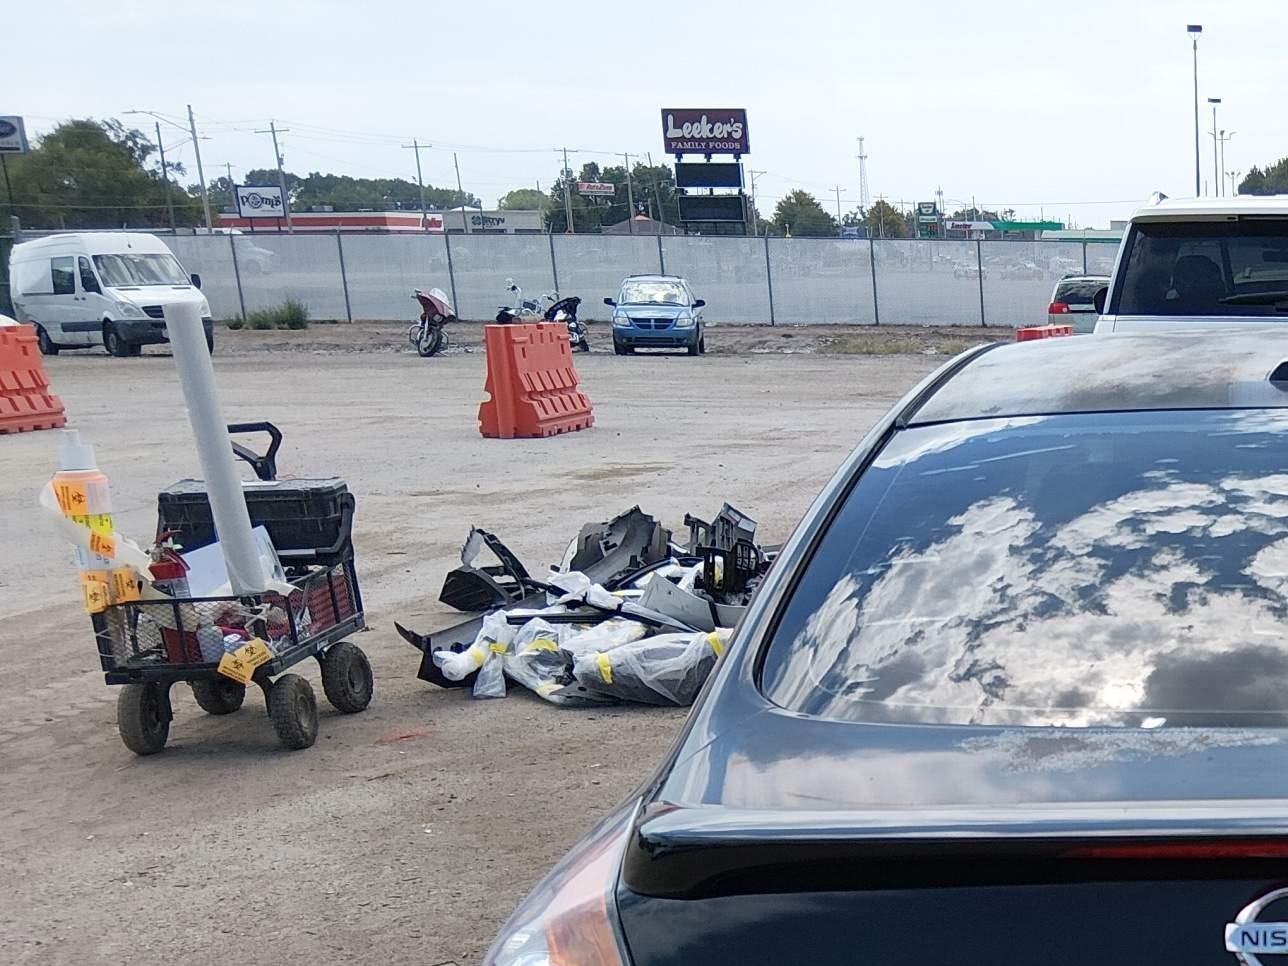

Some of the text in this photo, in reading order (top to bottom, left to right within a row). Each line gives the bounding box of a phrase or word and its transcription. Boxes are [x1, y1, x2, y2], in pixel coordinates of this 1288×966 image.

[666, 114, 743, 139] Leeker's
[671, 141, 741, 149] FAMILY FOODS
